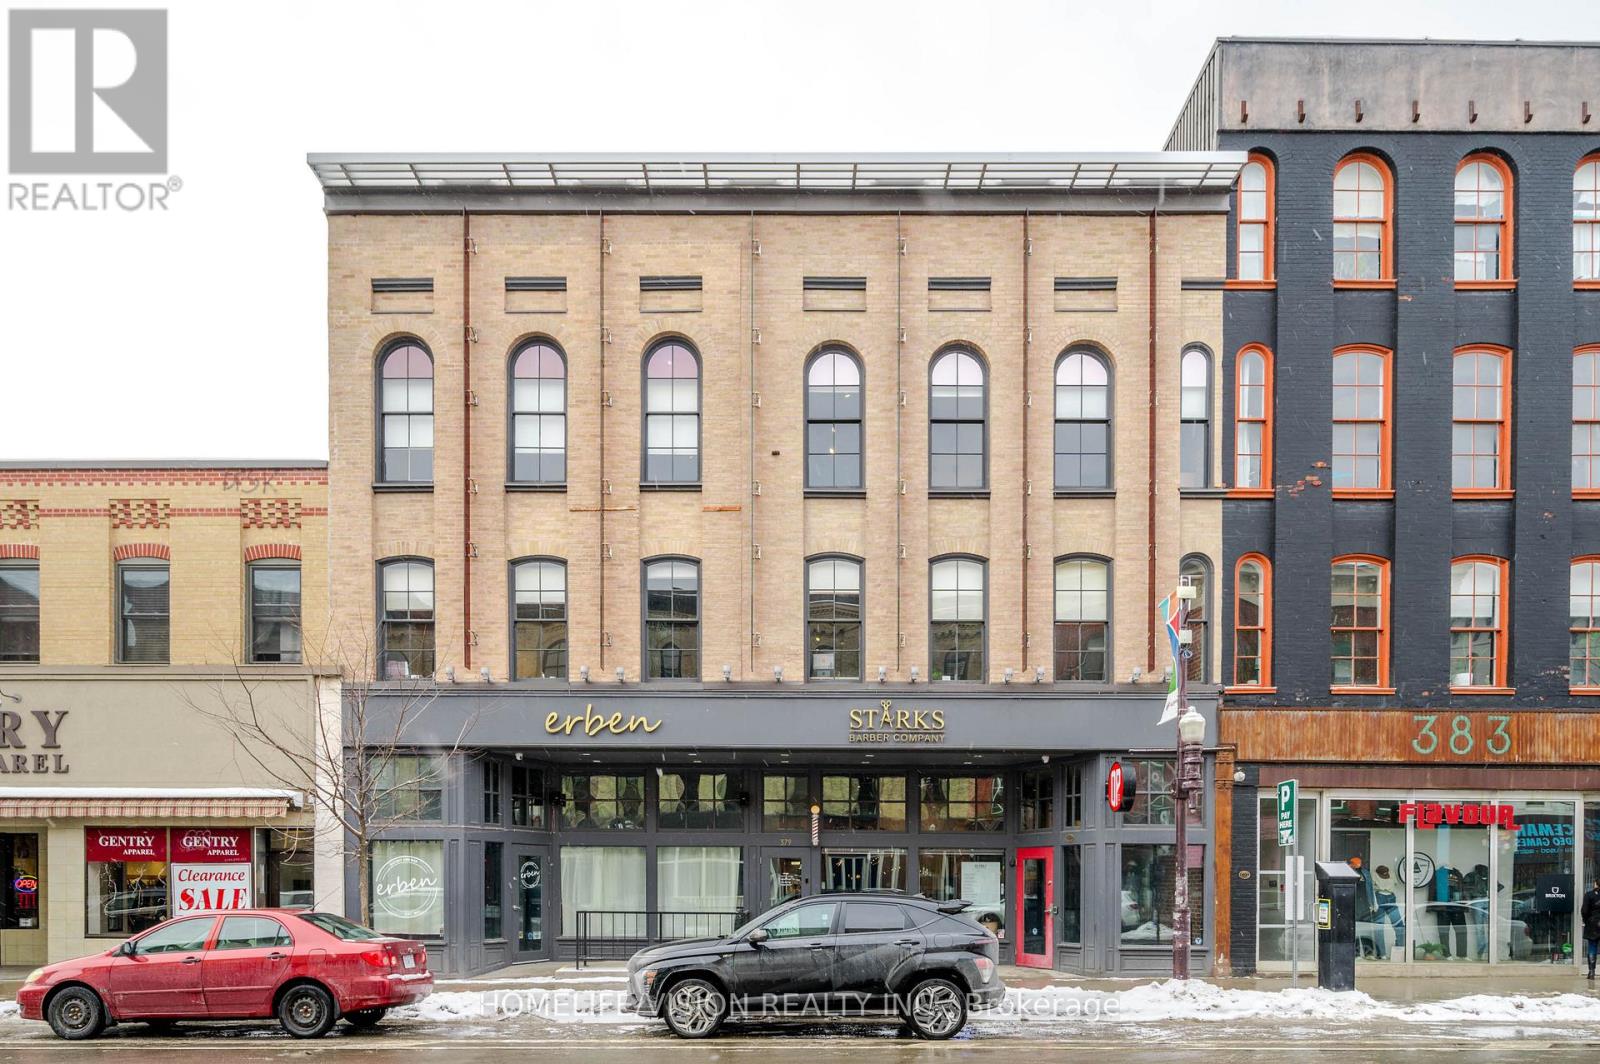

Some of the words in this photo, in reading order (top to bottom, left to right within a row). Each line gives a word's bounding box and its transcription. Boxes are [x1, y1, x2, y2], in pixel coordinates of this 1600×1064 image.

[545, 703, 662, 736] erben
[849, 700, 946, 730] STARKS
[0, 710, 69, 749] RY
[1411, 715, 1512, 755] 383
[848, 733, 890, 743] BARBER
[893, 733, 946, 743] COMPANY
[1280, 811, 1291, 820] PAY
[1279, 819, 1293, 829] HERE
[99, 835, 155, 847] GENTRY
[182, 836, 240, 847] GENTRY
[178, 868, 246, 882] Clearance
[16, 879, 38, 888] OPEN
[376, 875, 438, 896] erben
[178, 887, 248, 911] SALE
